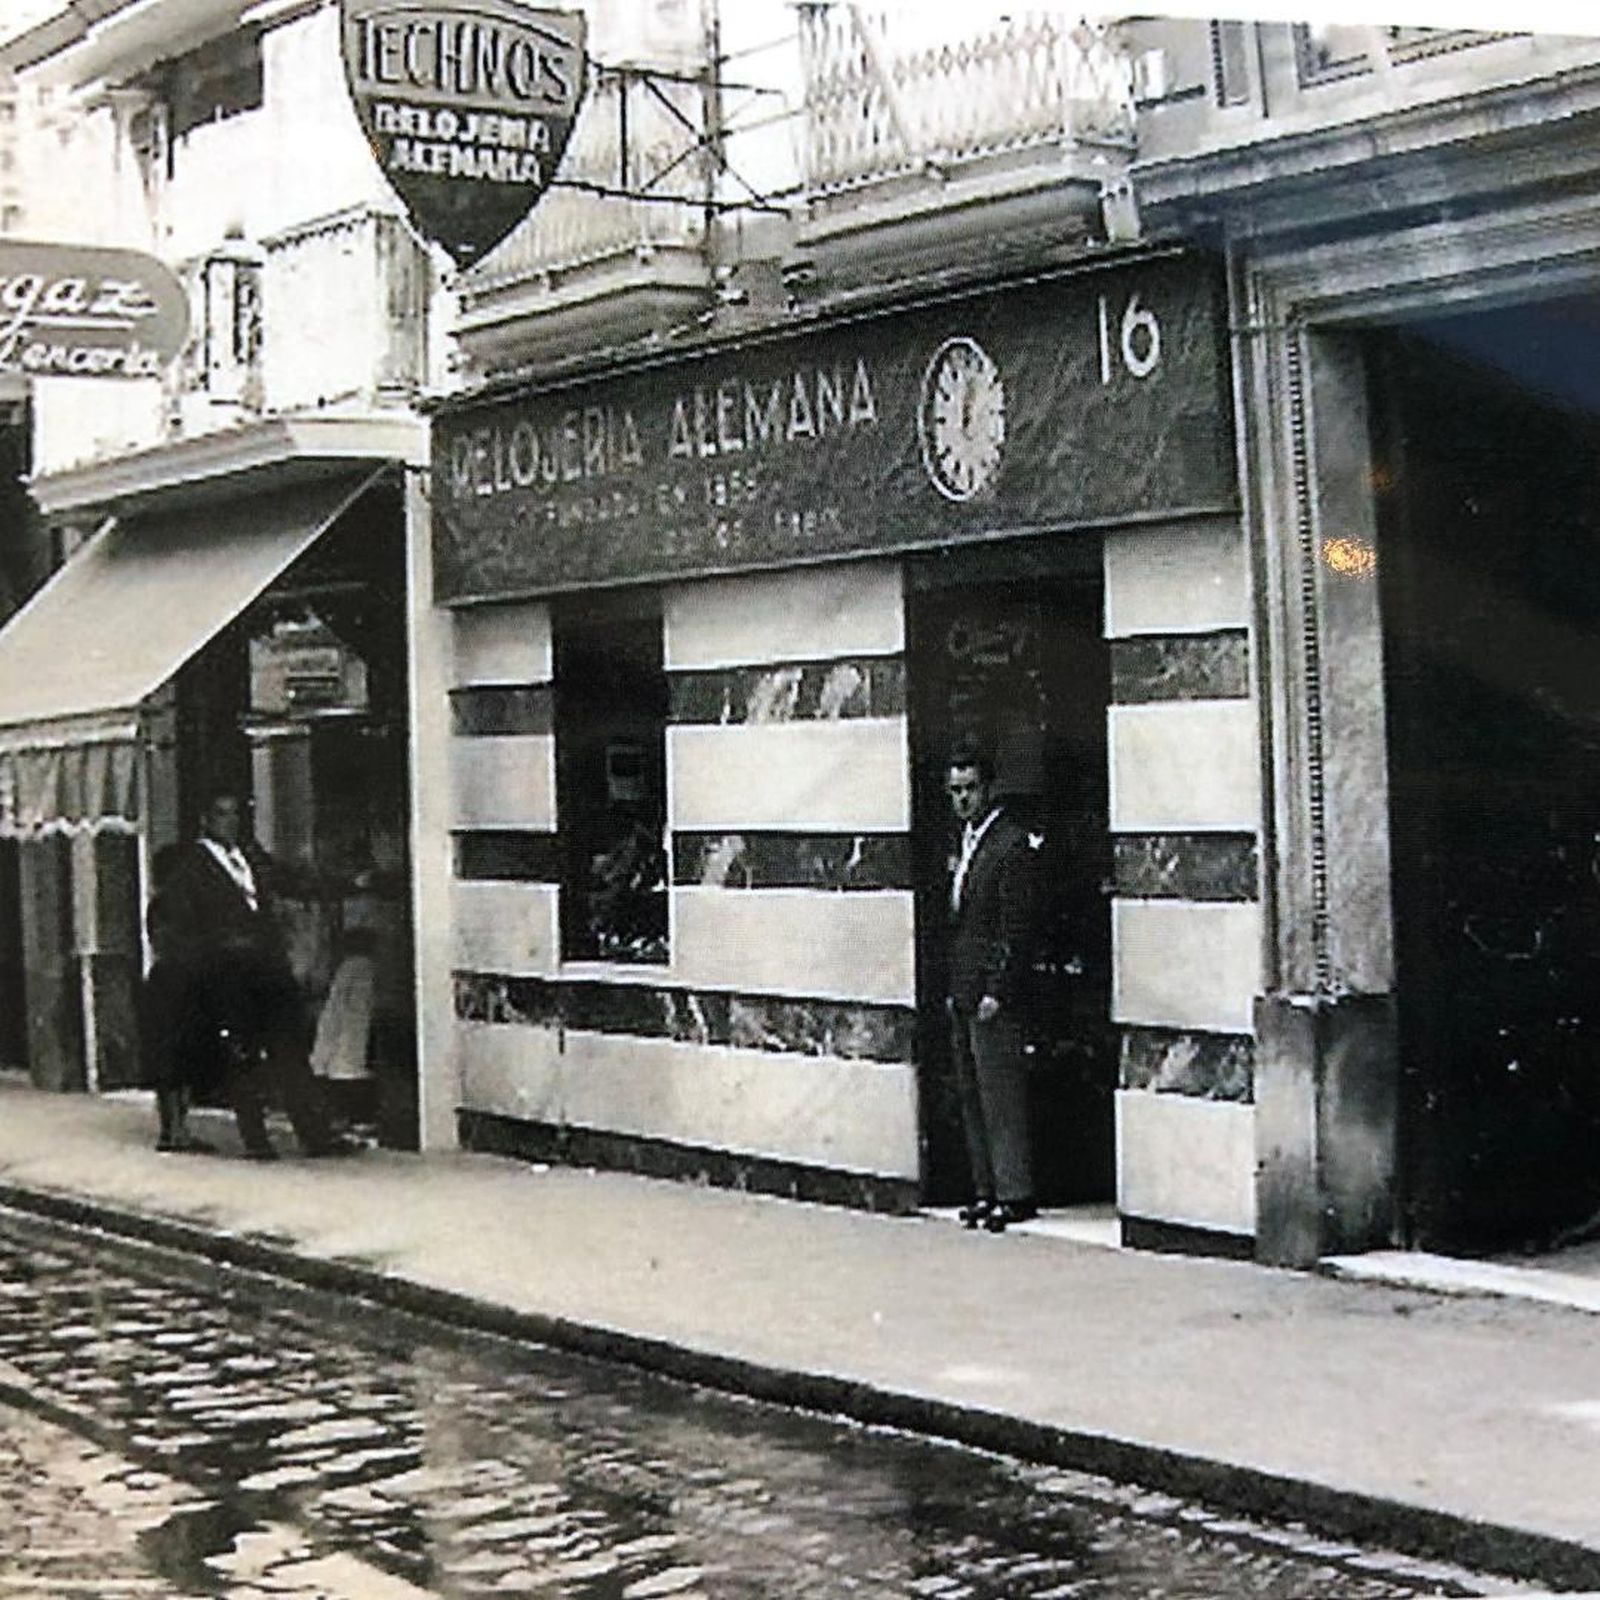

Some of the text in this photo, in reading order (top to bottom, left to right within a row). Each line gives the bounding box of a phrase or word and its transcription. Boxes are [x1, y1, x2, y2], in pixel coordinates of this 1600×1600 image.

[354, 18, 573, 104] TECHNOS
[1098, 292, 1161, 385] 16
[450, 356, 879, 499] RELOJERIA ALEMANA
